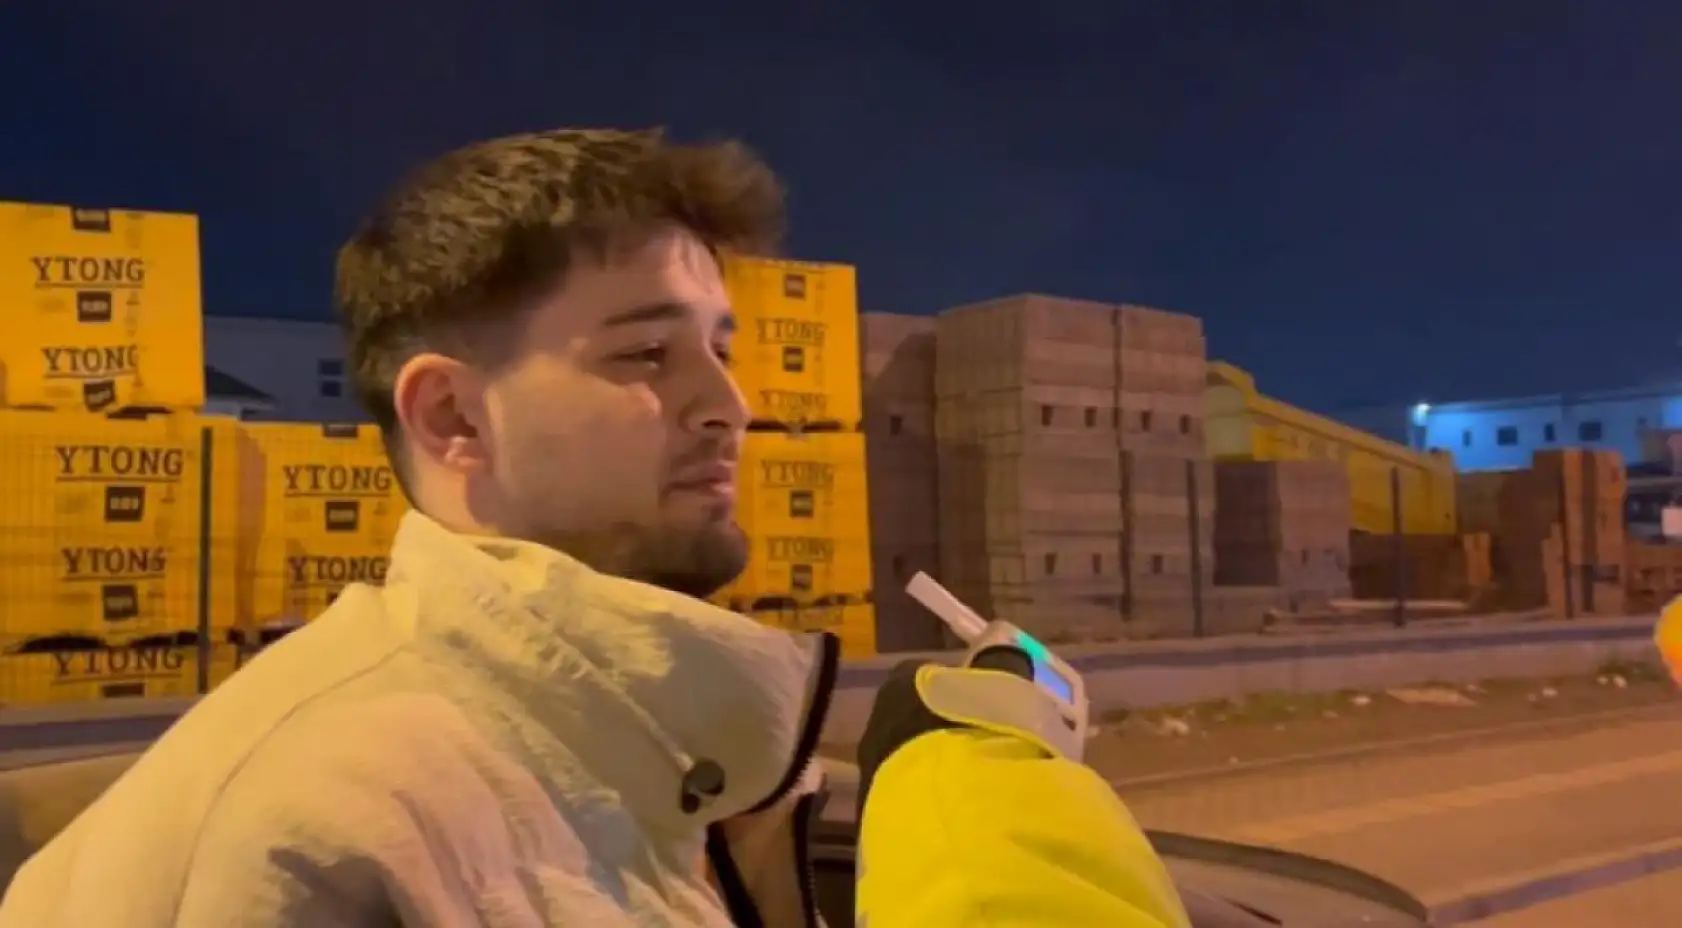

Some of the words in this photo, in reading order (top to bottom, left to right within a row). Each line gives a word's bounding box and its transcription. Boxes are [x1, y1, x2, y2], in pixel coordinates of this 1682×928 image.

[31, 256, 145, 282] YTONG
[56, 446, 183, 476] YTONG
[283, 465, 392, 492] YTONG
[52, 648, 184, 677] YTONG
